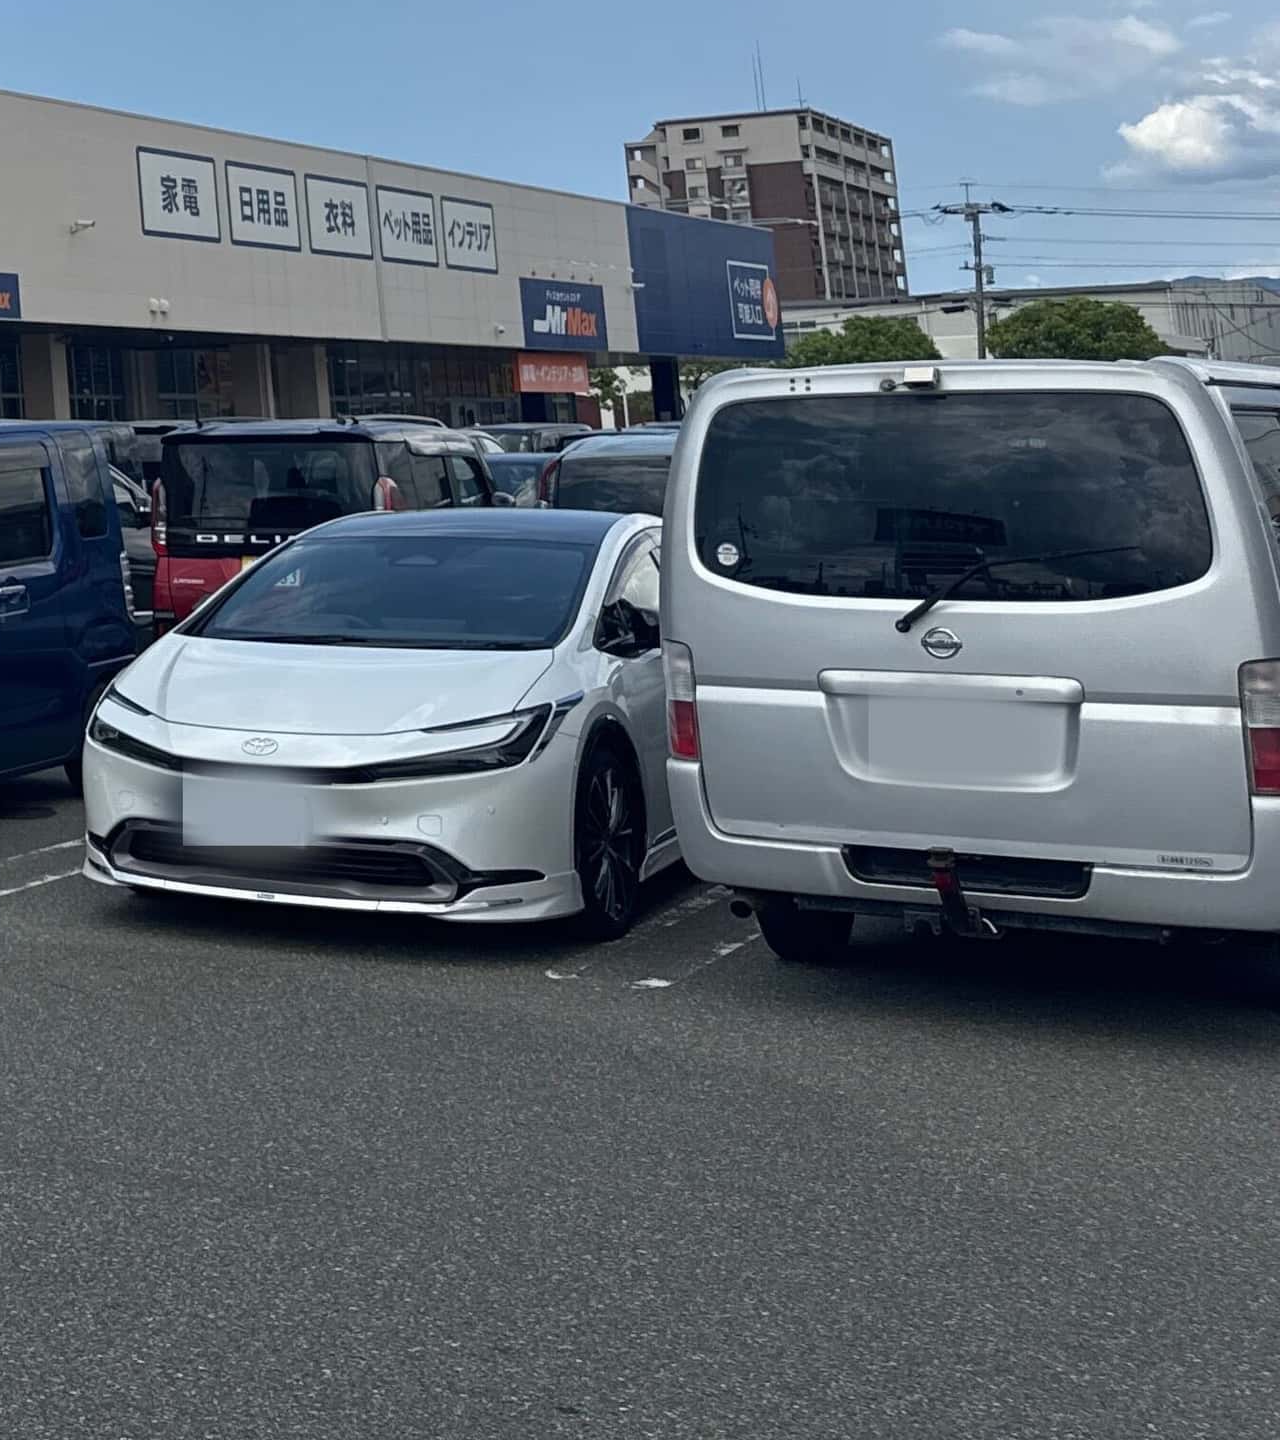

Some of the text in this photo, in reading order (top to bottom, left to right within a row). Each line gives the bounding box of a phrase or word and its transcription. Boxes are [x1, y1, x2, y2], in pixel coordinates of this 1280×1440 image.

[160, 175, 200, 217] 家電
[239, 186, 289, 227] 日用品
[324, 198, 355, 237] 衣料
[383, 209, 433, 245] ペット用品
[448, 219, 491, 251] インテリア
[533, 305, 598, 336] MrMax
